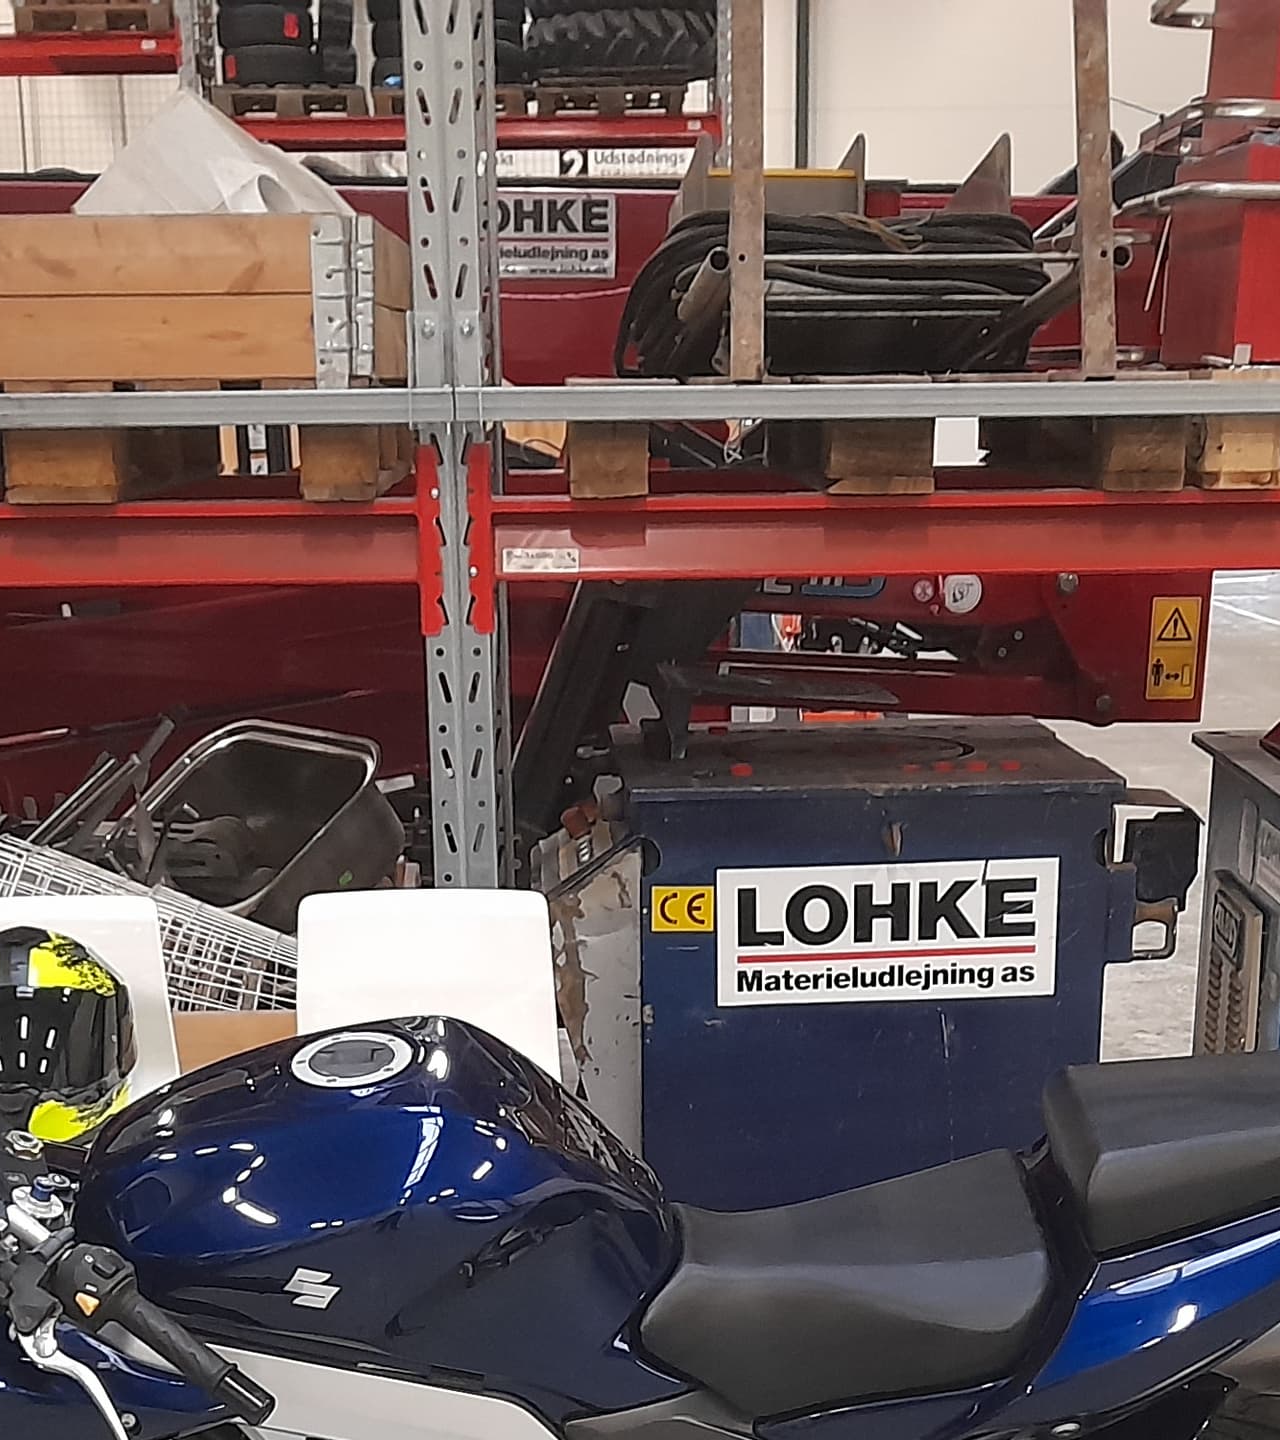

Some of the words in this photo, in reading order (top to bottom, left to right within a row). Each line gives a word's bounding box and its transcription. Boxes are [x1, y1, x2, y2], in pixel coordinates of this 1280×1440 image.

[497, 198, 609, 233] HKE
[737, 877, 1037, 948] LOHKE
[737, 962, 995, 992] Materieludlejning
[1000, 963, 1035, 983] as
